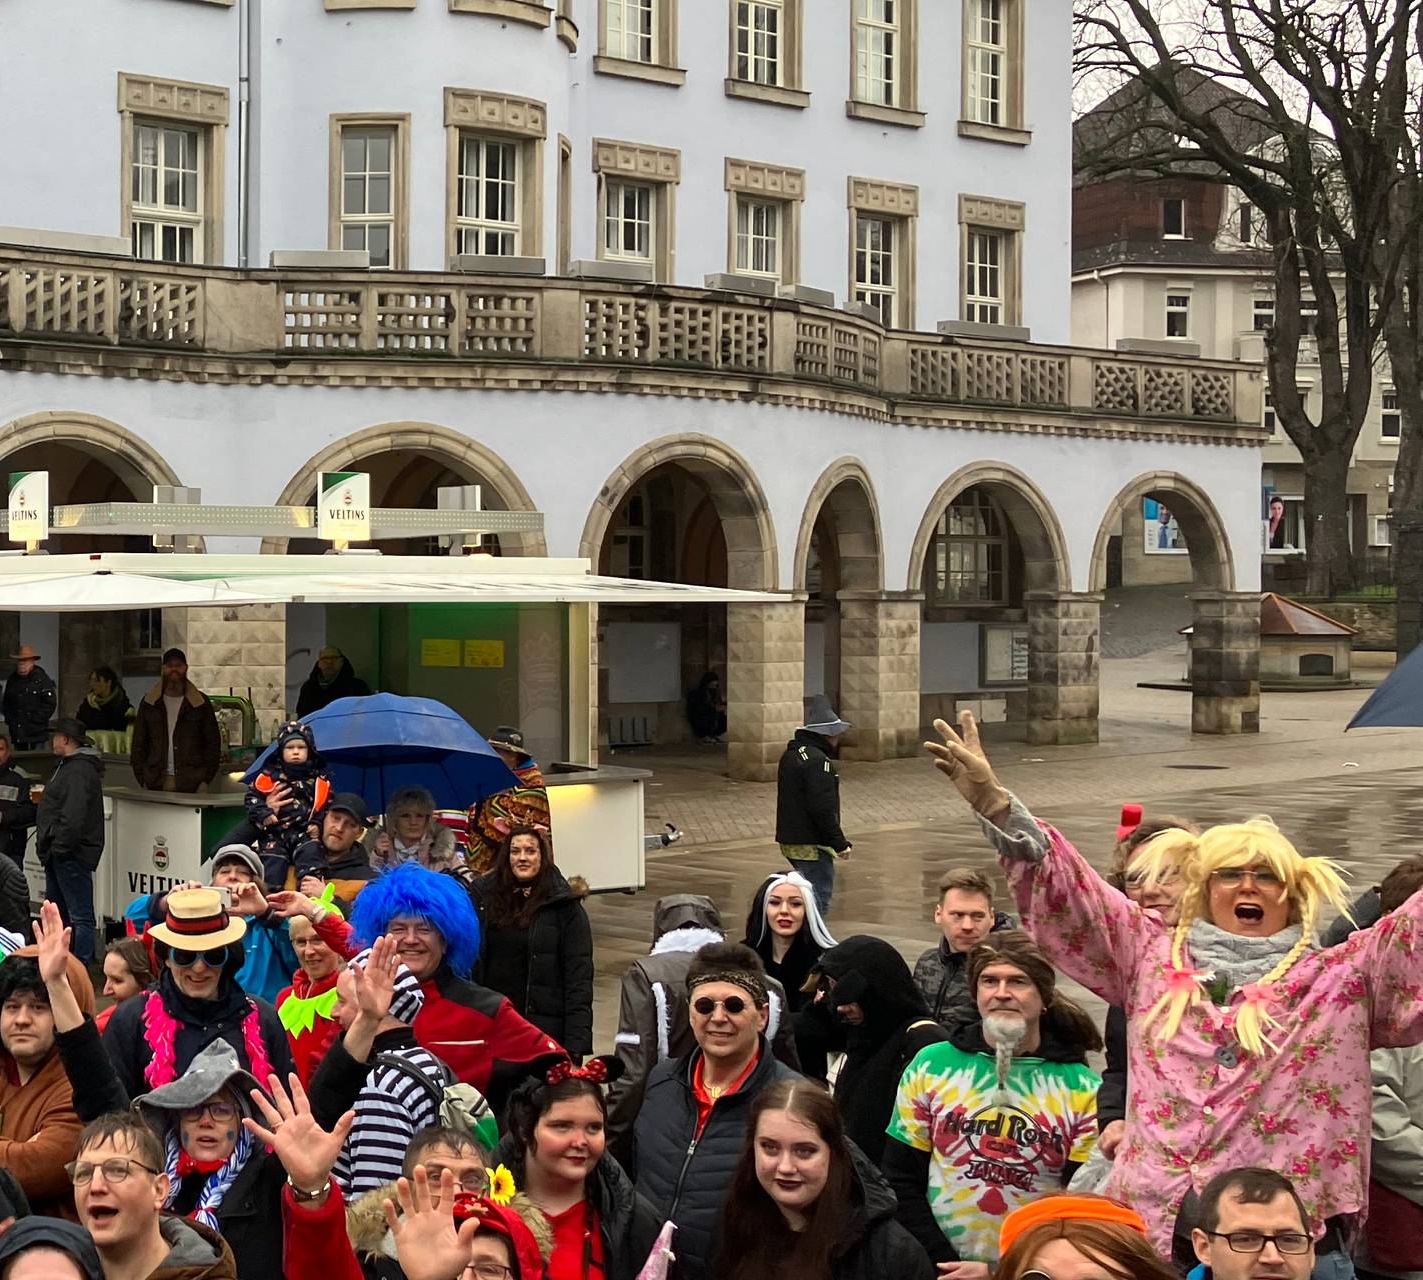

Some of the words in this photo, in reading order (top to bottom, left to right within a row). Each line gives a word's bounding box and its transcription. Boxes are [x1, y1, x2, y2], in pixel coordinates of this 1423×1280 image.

[329, 509, 365, 521] VELTINS
[128, 871, 185, 895] VELTI
[943, 1112, 1006, 1137] Hard
[1007, 1114, 1064, 1156] Rock
